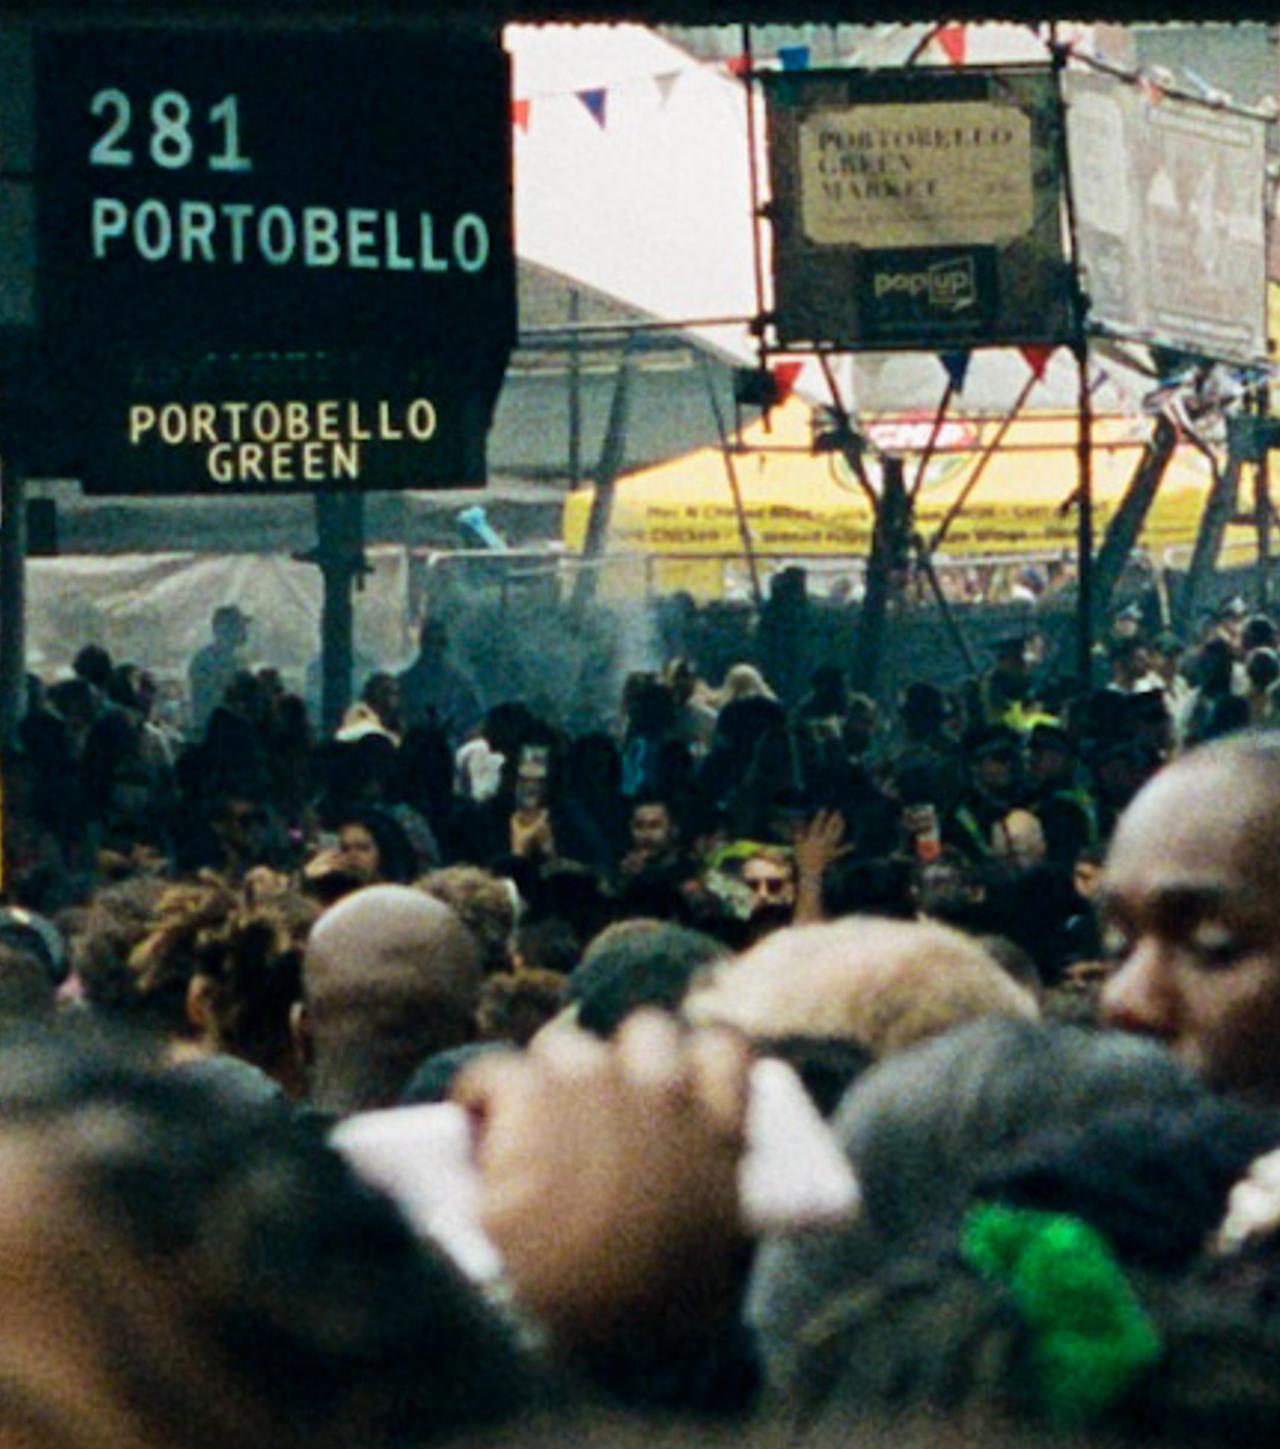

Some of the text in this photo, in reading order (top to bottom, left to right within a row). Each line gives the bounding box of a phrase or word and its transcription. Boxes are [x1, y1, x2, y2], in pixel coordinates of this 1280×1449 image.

[89, 88, 253, 172] 281
[91, 197, 490, 273] PORTOBELLO
[130, 398, 436, 445] PORTOBELLO
[207, 441, 359, 483] GREEN
